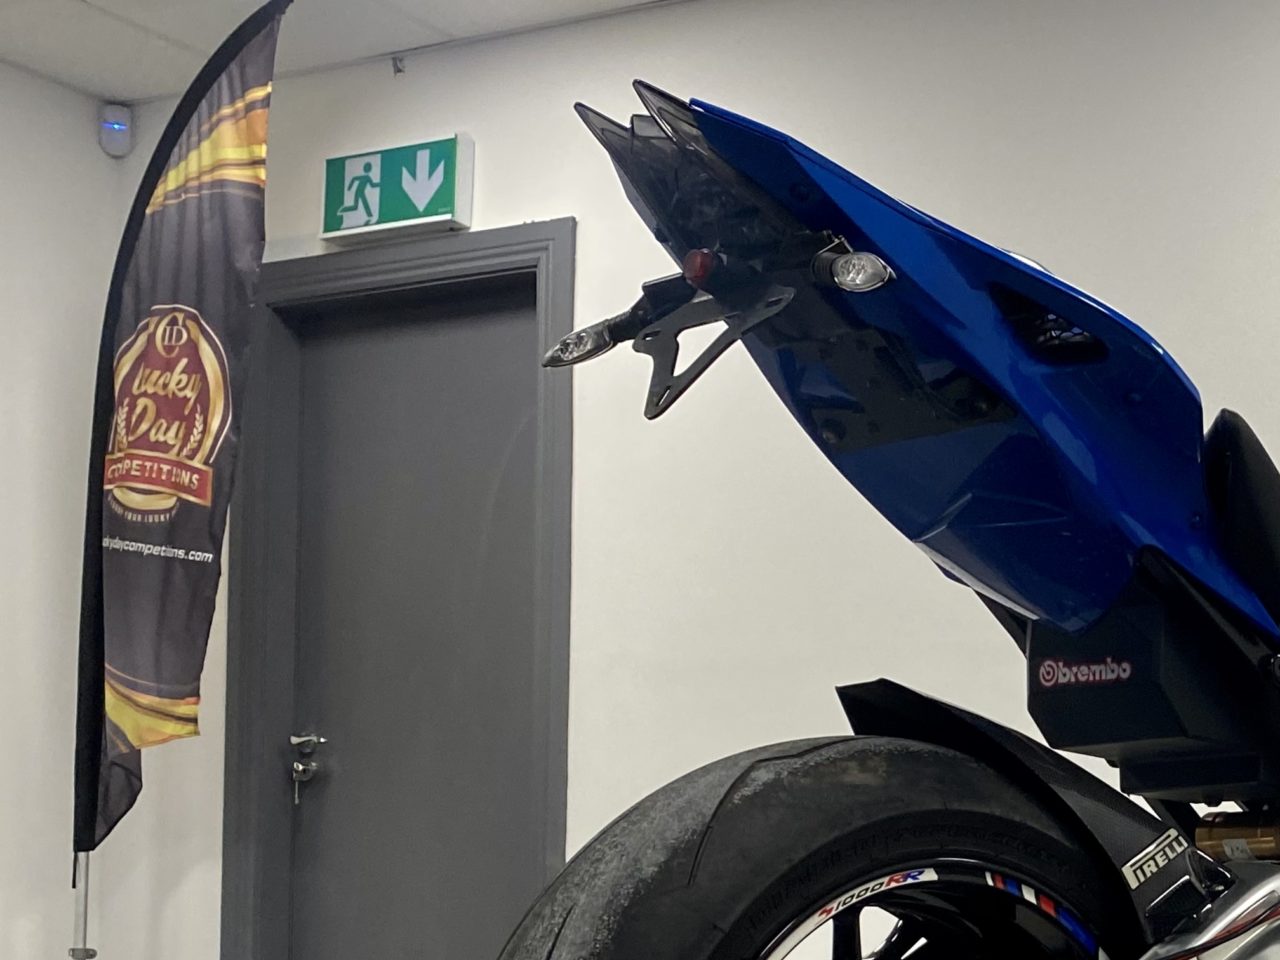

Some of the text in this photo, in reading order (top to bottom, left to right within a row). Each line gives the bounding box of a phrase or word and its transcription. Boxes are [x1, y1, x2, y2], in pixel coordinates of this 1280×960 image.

[128, 397, 186, 457] Day
[1058, 657, 1132, 683] brembo
[1121, 827, 1189, 890] PIRELLI
